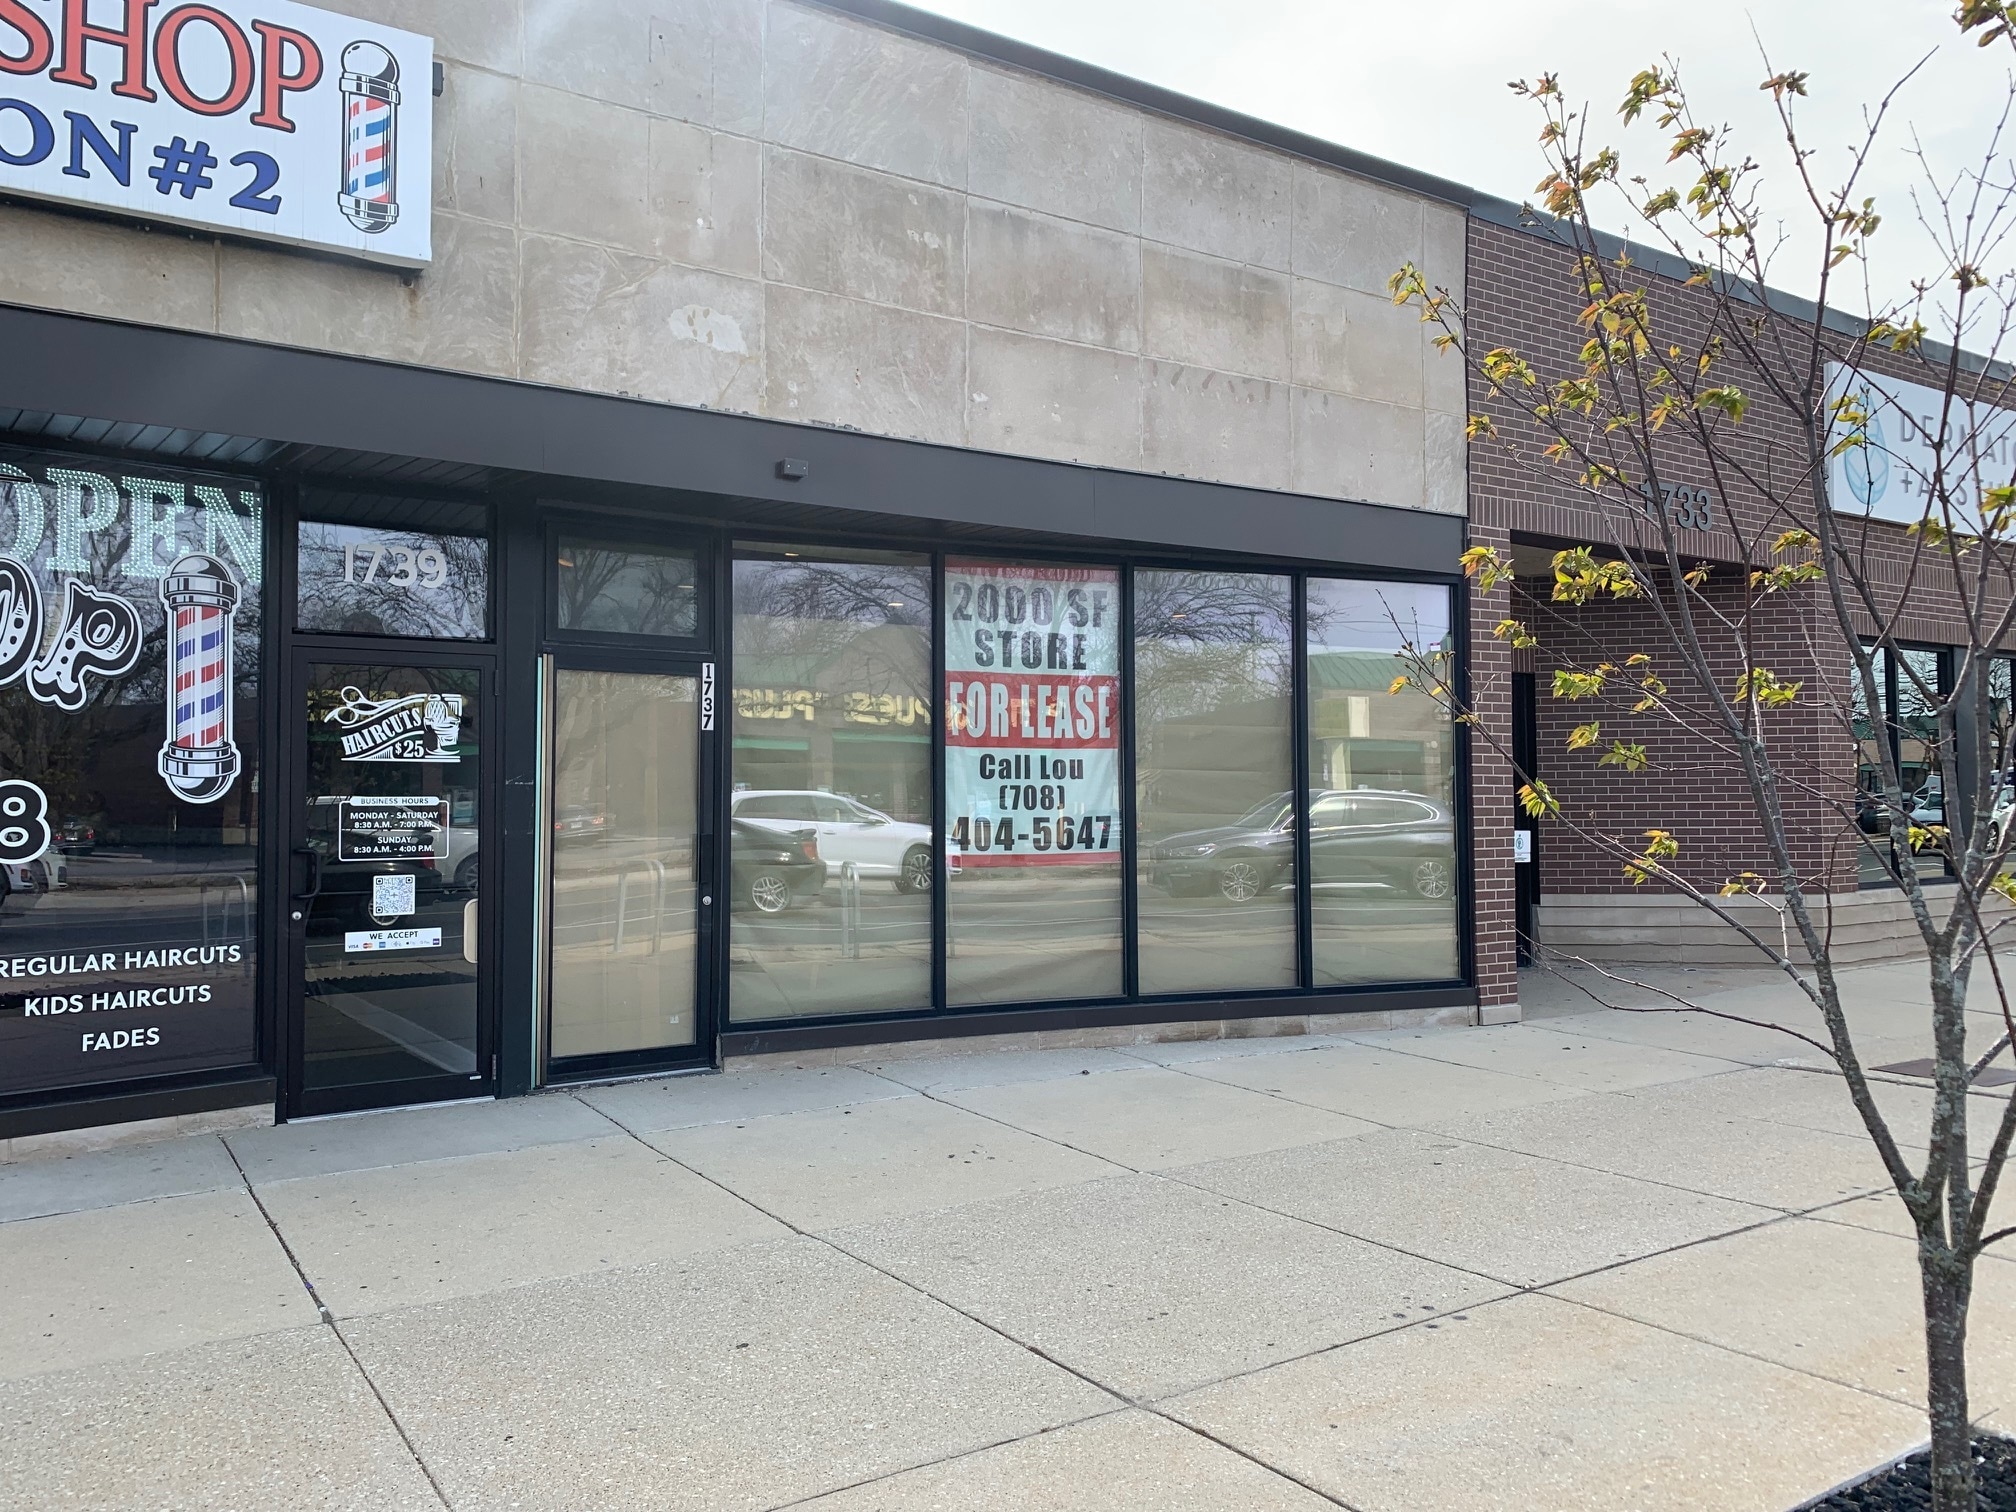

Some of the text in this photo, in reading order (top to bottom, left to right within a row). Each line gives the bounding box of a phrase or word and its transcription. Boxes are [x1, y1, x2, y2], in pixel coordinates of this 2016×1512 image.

[0, 0, 324, 133] SHOP
[148, 136, 283, 215] #2
[1639, 479, 1713, 532] 1733
[343, 544, 448, 589] 1739
[952, 581, 1109, 628] 2000 SF
[974, 627, 1087, 671] STORE
[703, 664, 713, 729] 1737
[949, 681, 1008, 738] FOR
[1021, 683, 1111, 739] LEASE
[340, 706, 423, 756] HAIRCUTS
[394, 739, 425, 758] $25
[979, 752, 1084, 780] Call Lou
[999, 784, 1065, 811] (708)
[350, 812, 388, 820] MONDAY
[396, 811, 438, 819] SATURDAY
[354, 821, 372, 829] 8:30
[952, 814, 1111, 851] 404-5647
[353, 846, 372, 854] 8:30
[373, 845, 392, 853] A.M.
[398, 844, 417, 852] 4:00
[418, 844, 434, 852] P.M.
[377, 836, 411, 844] SUNDAY
[369, 931, 418, 940] WE ACCEPT
[0, 944, 241, 978] REGULAR HAIRCUTS
[24, 984, 212, 1017] KIDS HAIRCUTS
[82, 1026, 160, 1052] FADES
